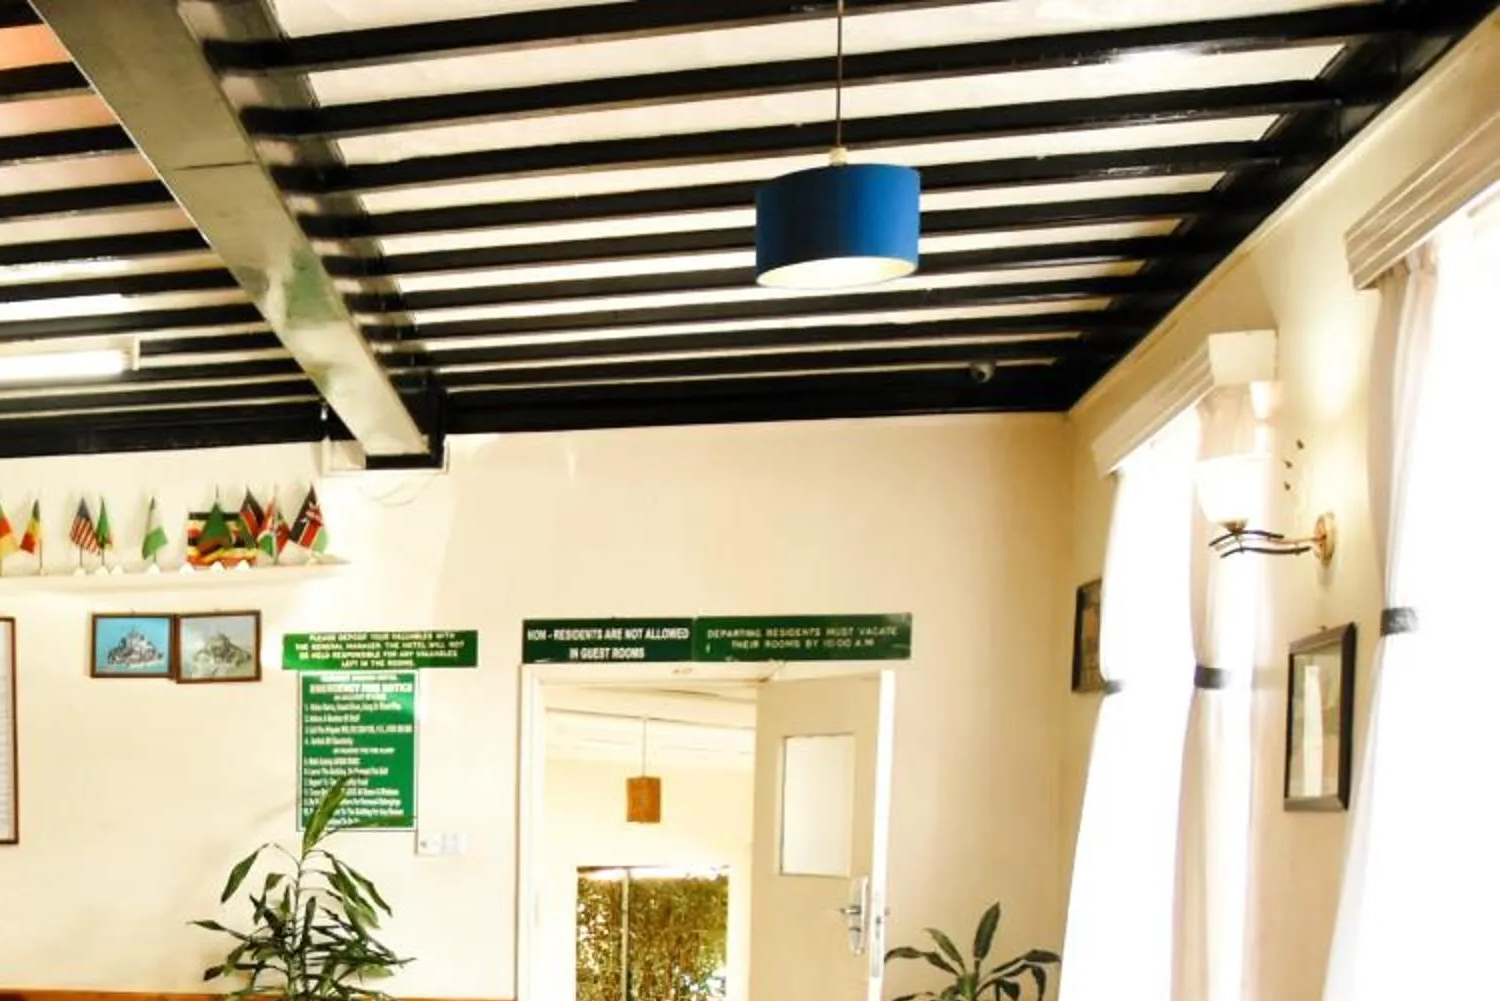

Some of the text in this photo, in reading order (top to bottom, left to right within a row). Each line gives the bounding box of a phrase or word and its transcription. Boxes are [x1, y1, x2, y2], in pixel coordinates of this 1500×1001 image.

[528, 629, 547, 640] NON
[553, 628, 603, 641] RESIDENTS
[604, 628, 622, 640] ARE
[624, 628, 644, 640] NOT
[645, 627, 690, 640] ALLOWED
[707, 626, 897, 639] DEPARTING RESIDENTS MUST VACATE
[311, 642, 343, 651] GENERAL
[384, 641, 399, 650] THE
[401, 641, 427, 650] HOTEL
[429, 641, 446, 650] WILL
[448, 640, 465, 649] NOT
[731, 639, 759, 649] THEIR
[764, 639, 800, 649] ROOMS
[805, 639, 819, 649] BY
[332, 650, 380, 660] RESPONSIBLE
[383, 650, 397, 658] FOR
[399, 650, 414, 658] ANY
[415, 649, 458, 658] VALUABLES
[569, 647, 645, 659] IN GUEST ROOMS
[341, 659, 358, 669] LEFT
[360, 659, 369, 668] IN
[371, 658, 385, 668] THE
